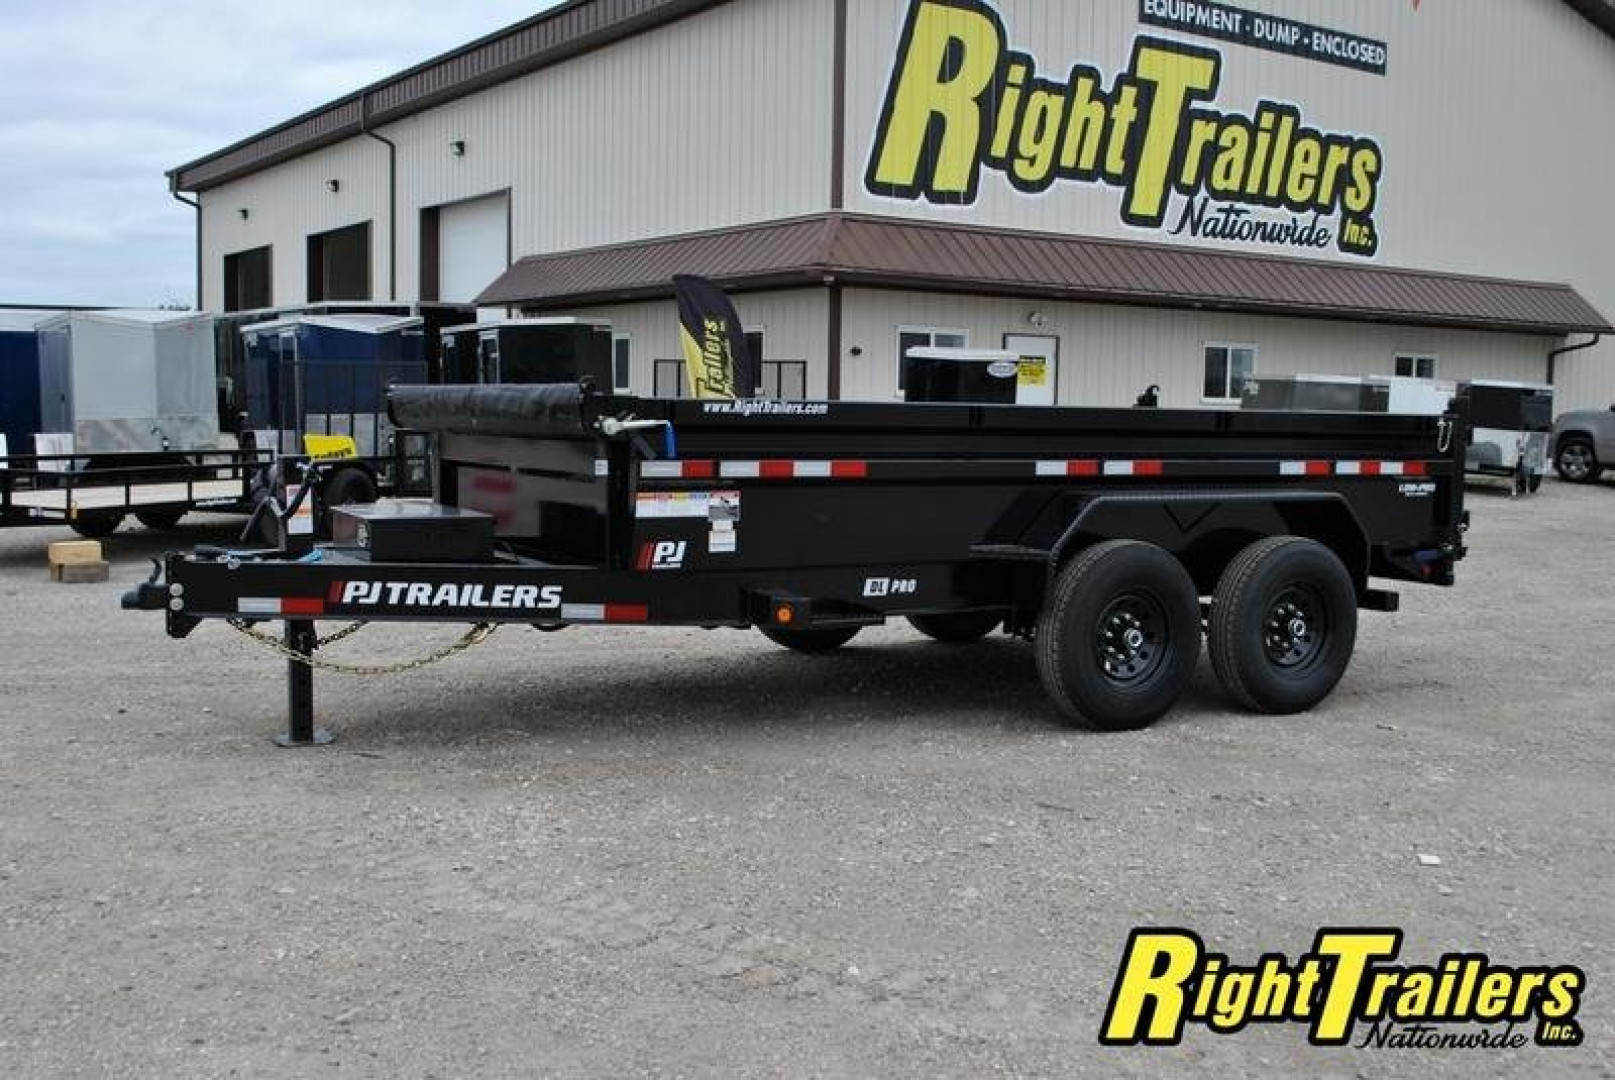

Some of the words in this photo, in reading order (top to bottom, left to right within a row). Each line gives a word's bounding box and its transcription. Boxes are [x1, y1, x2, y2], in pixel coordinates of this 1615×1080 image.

[1144, 0, 1242, 33] EQUIPMENT
[1253, 18, 1300, 45] DUMP
[1311, 32, 1385, 65] ENCLOSED
[1168, 197, 1332, 248] Nationwide
[1343, 217, 1373, 248] Inc.
[653, 541, 687, 562] PJ
[342, 580, 383, 604] PJ
[386, 582, 563, 609] TRAILERS
